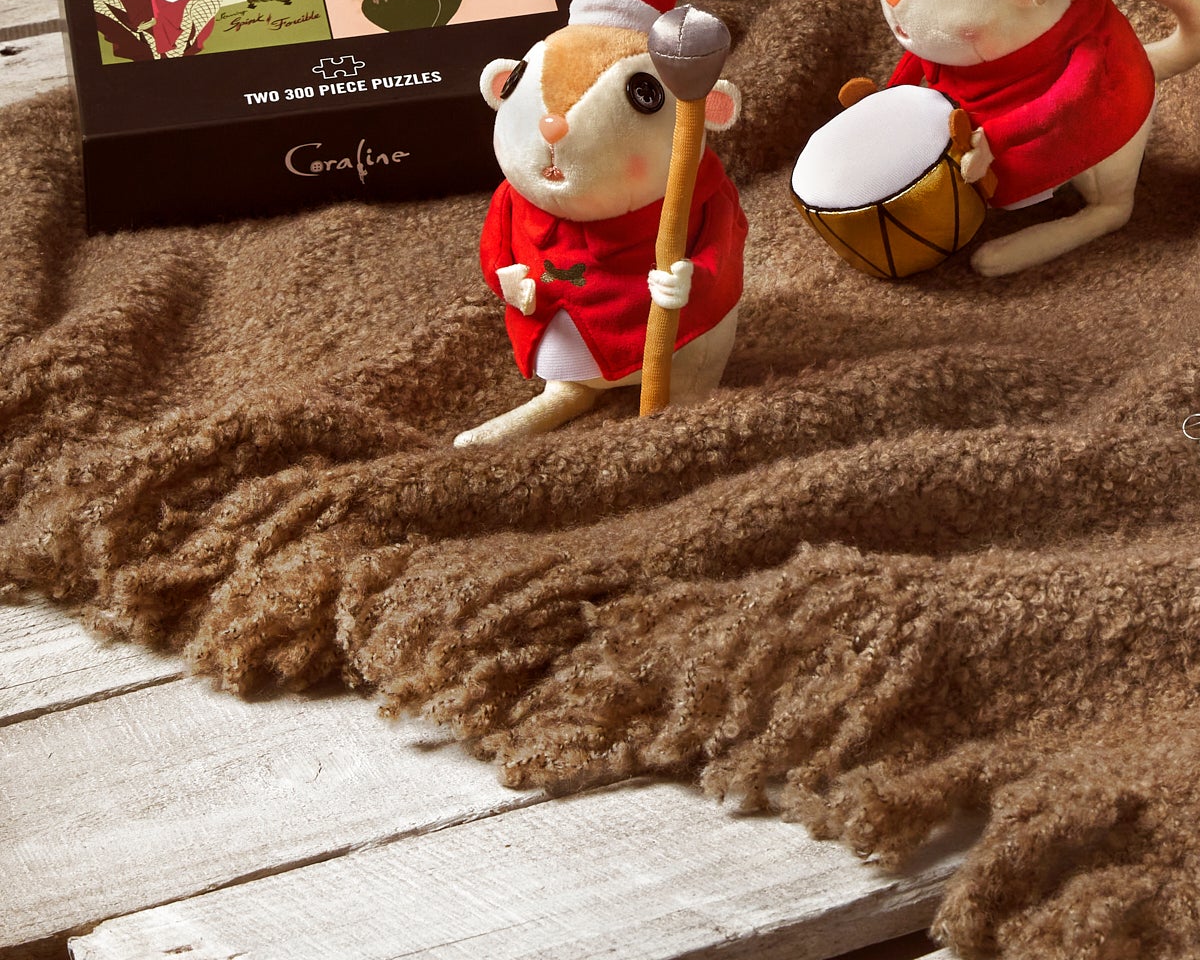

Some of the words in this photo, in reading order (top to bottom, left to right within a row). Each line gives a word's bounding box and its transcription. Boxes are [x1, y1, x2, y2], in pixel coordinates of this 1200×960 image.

[268, 10, 321, 30] Forcible
[243, 90, 280, 105] TWO
[284, 86, 315, 101] 300
[319, 79, 368, 96] PIECE
[371, 71, 442, 89] PUZZLES
[284, 138, 410, 184] Coraline
